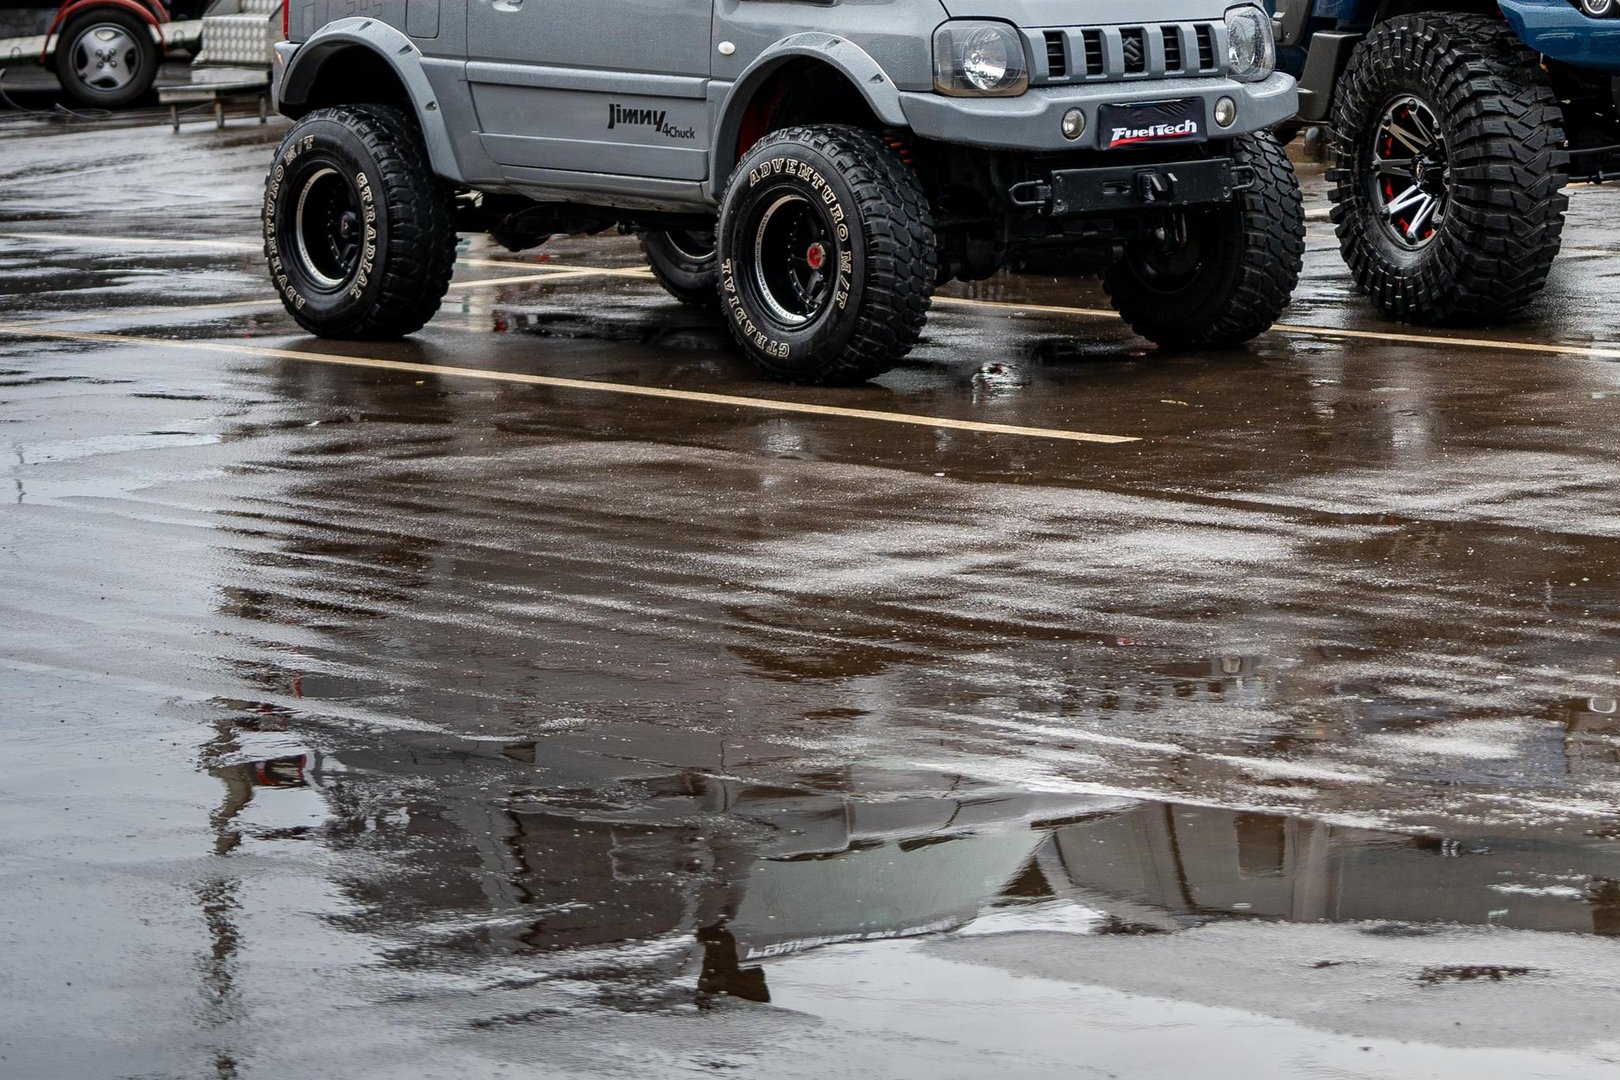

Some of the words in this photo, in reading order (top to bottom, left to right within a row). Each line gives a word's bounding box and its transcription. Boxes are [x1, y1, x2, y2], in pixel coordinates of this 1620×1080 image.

[607, 103, 667, 132] Jimny
[661, 122, 695, 139] 4Chuck
[1111, 120, 1197, 141] FuelTech
[283, 135, 314, 166] M/T
[265, 165, 306, 310] ADVENTURO
[750, 157, 849, 242] ADVENTURO
[836, 250, 852, 310] M/T
